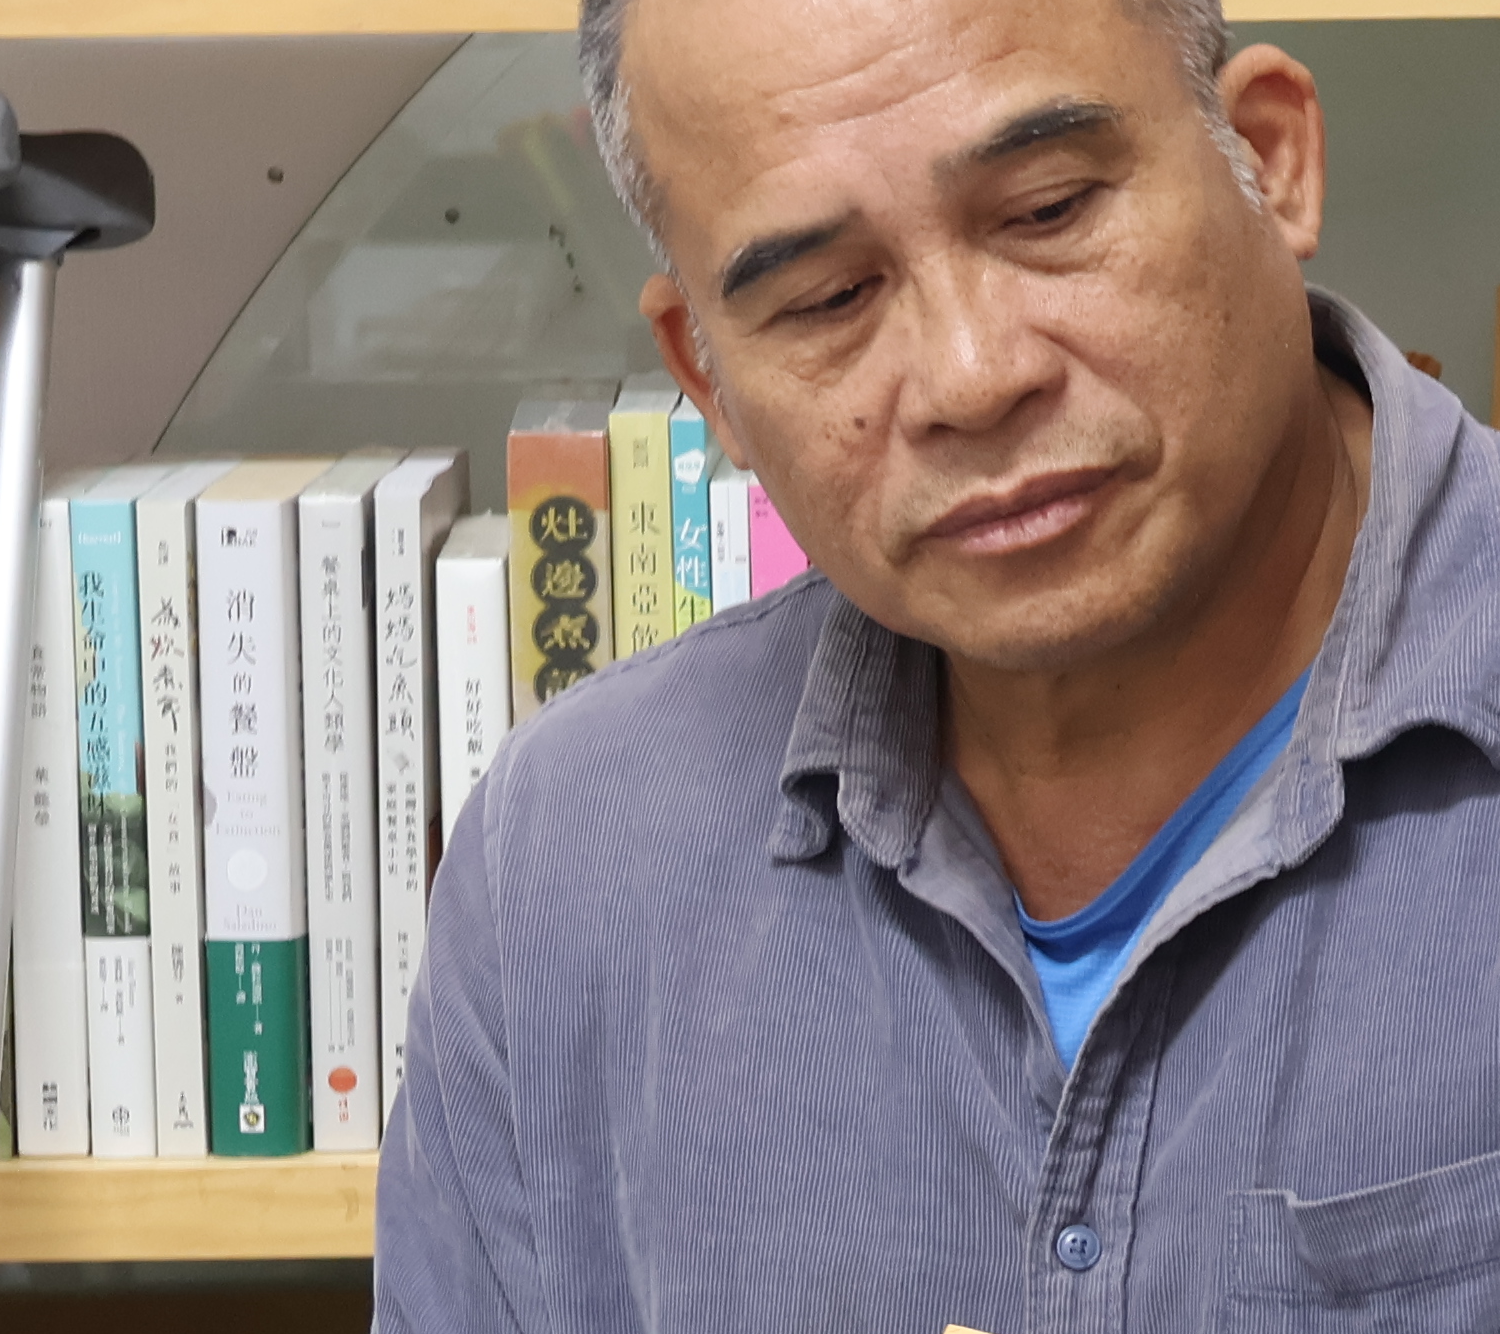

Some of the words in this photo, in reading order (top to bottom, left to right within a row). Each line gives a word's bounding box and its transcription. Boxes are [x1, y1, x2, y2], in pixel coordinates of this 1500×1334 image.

[225, 587, 259, 779] 消失的餐盤
[319, 553, 345, 754] 餐桌上的文化人類學
